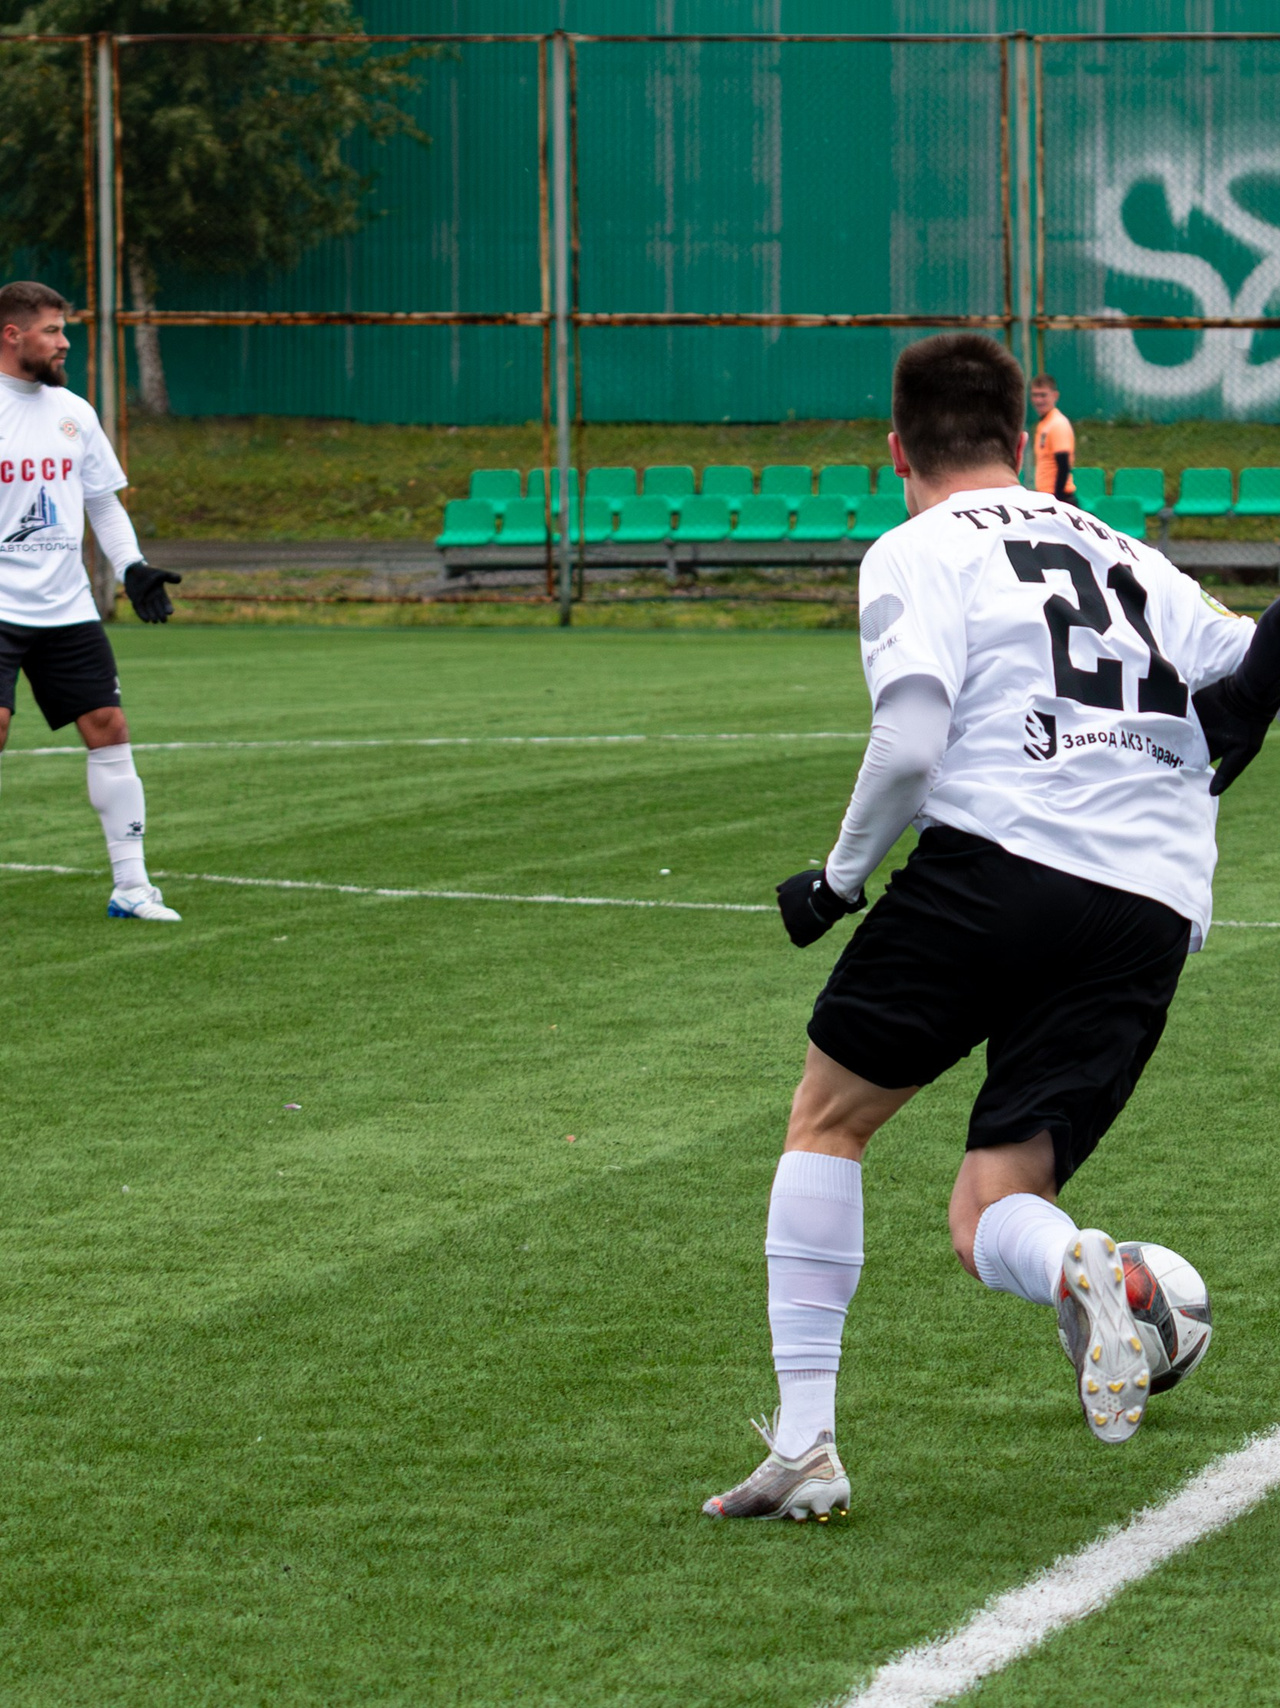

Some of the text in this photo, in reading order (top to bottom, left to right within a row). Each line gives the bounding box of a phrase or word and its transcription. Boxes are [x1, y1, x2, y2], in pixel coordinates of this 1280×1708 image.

[0, 457, 73, 483] СССР
[1004, 539, 1188, 718] 21
[1062, 729, 1118, 749] Завод
[1120, 730, 1144, 752] АКЗ
